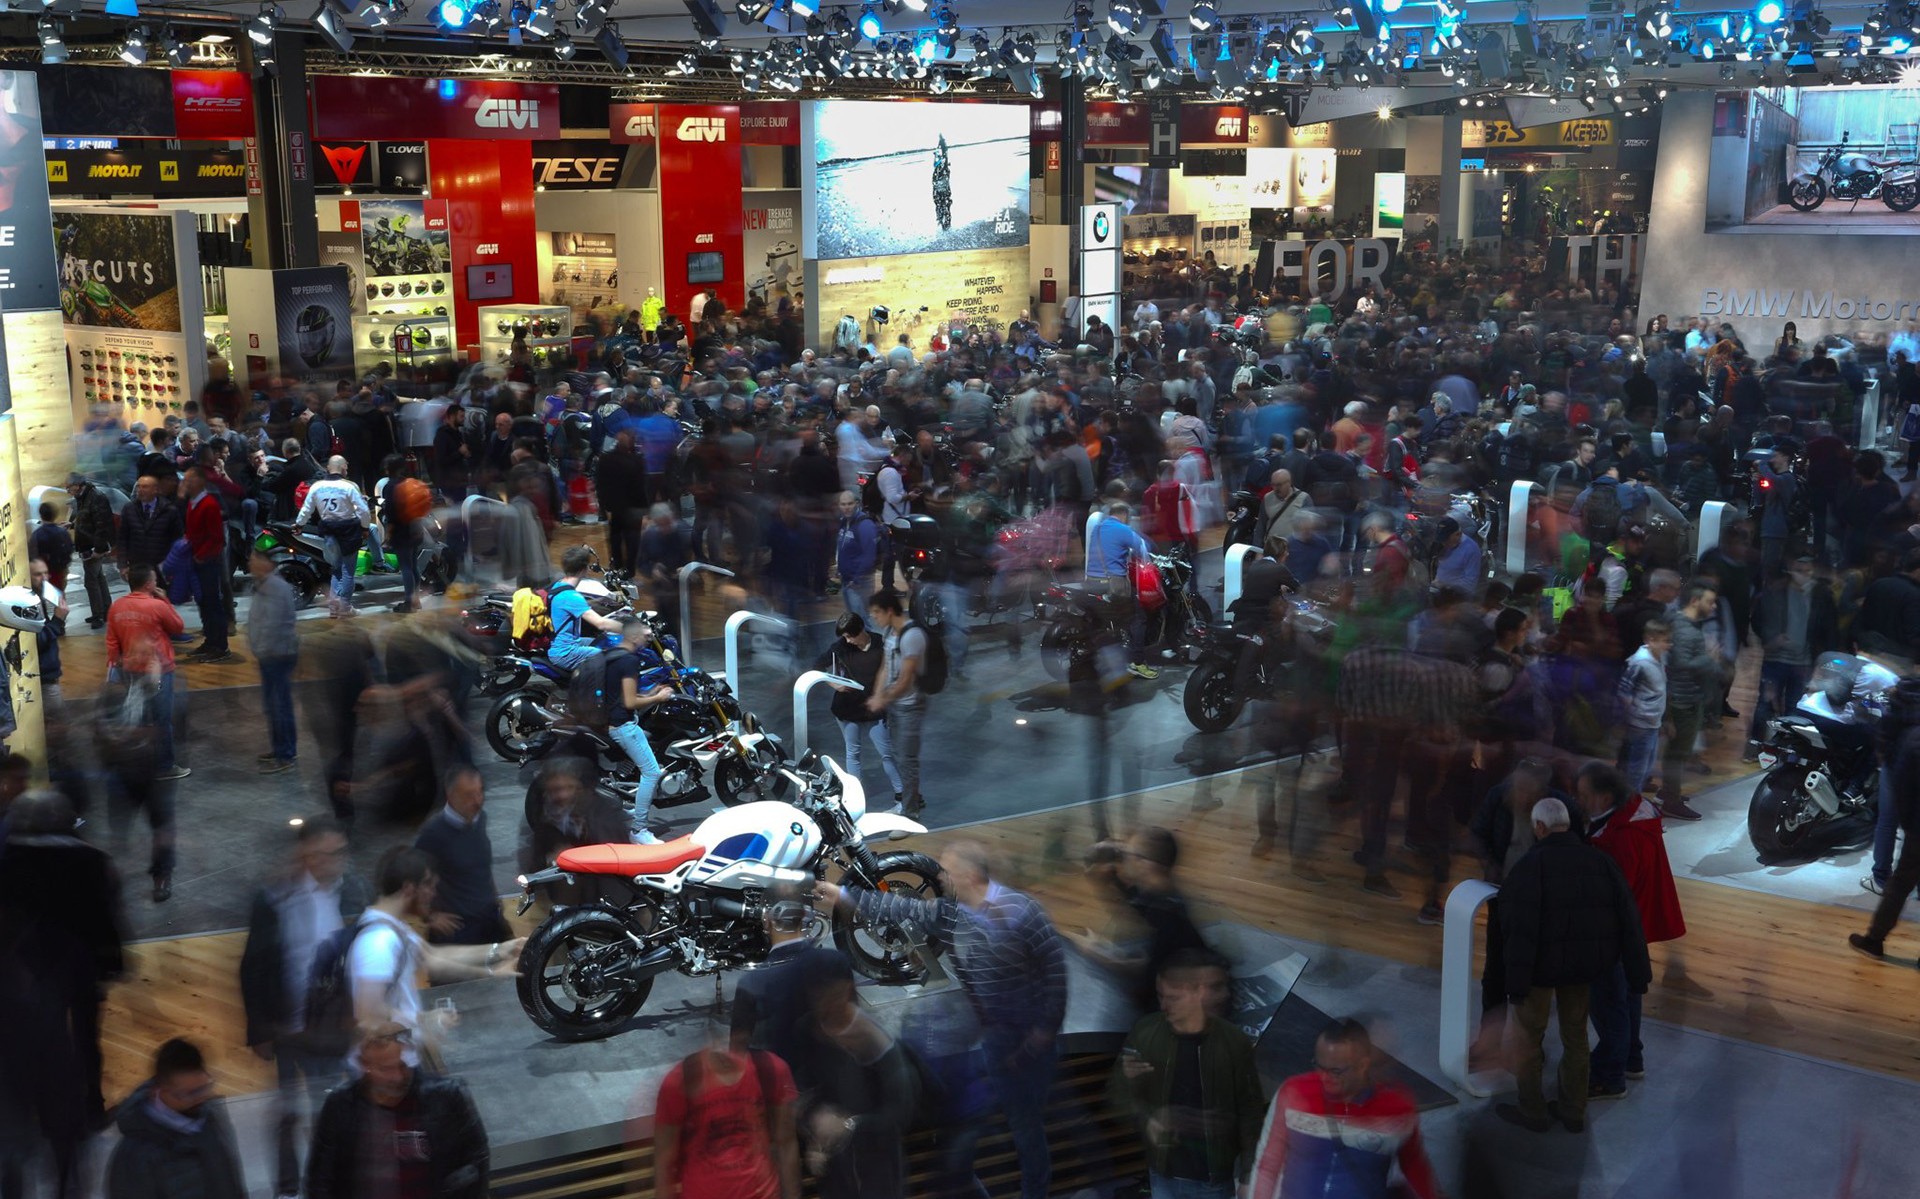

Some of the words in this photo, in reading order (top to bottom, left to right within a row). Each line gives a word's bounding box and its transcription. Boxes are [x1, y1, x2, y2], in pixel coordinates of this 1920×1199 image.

[1157, 99, 1171, 110] 14
[475, 99, 539, 130] GIVI
[625, 116, 656, 137] GIV
[769, 117, 789, 127] ENJOY
[676, 117, 726, 143] GIVI
[1153, 123, 1177, 155] H
[88, 165, 143, 178] MOTO.IT
[743, 208, 768, 230] NEW
[995, 221, 1016, 234] RIDE.
[695, 234, 713, 243] GIVI
[476, 244, 499, 255] GIVI
[1273, 239, 1389, 304] FOR
[964, 276, 996, 287] WHATEVER
[946, 299, 963, 308] KEEP
[1699, 287, 1796, 318] BMW
[978, 305, 990, 315] ARE
[990, 304, 1000, 313] NO
[322, 498, 338, 512] 75
